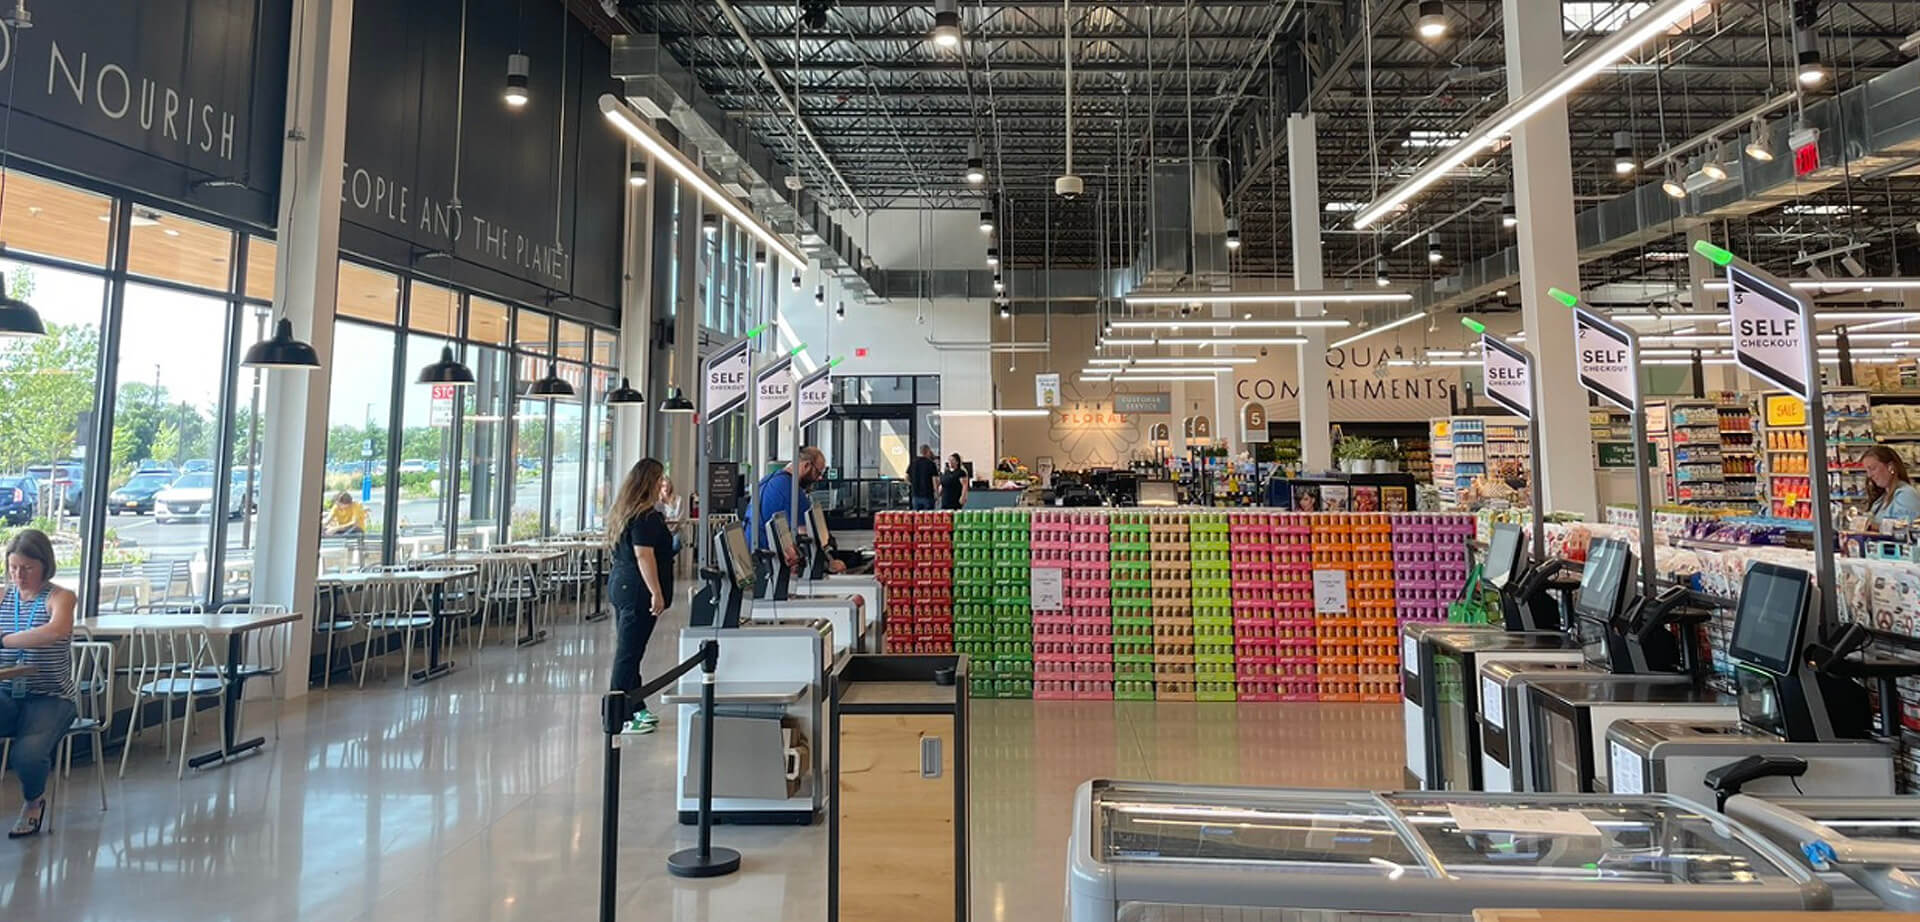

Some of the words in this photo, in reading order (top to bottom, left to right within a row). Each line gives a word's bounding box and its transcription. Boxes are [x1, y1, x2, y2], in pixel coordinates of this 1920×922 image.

[48, 40, 235, 161] NOURISH
[473, 215, 508, 260] THE
[1740, 319, 1796, 337] SELF
[1579, 330, 1586, 339] 2
[1740, 338, 1799, 348] CHECKOUT
[1583, 350, 1626, 363] SELF
[1488, 367, 1525, 380] SELF
[1583, 364, 1628, 373] CHECKOUT
[711, 372, 744, 383] SELF
[433, 386, 455, 398] STO
[761, 384, 789, 394] SELF
[1237, 378, 1449, 400] COMITMENTS
[802, 391, 827, 401] SELF
[1776, 404, 1797, 417] SALE
[1251, 412, 1260, 426] 5
[1159, 428, 1166, 437] 2
[1198, 423, 1206, 433] 4
